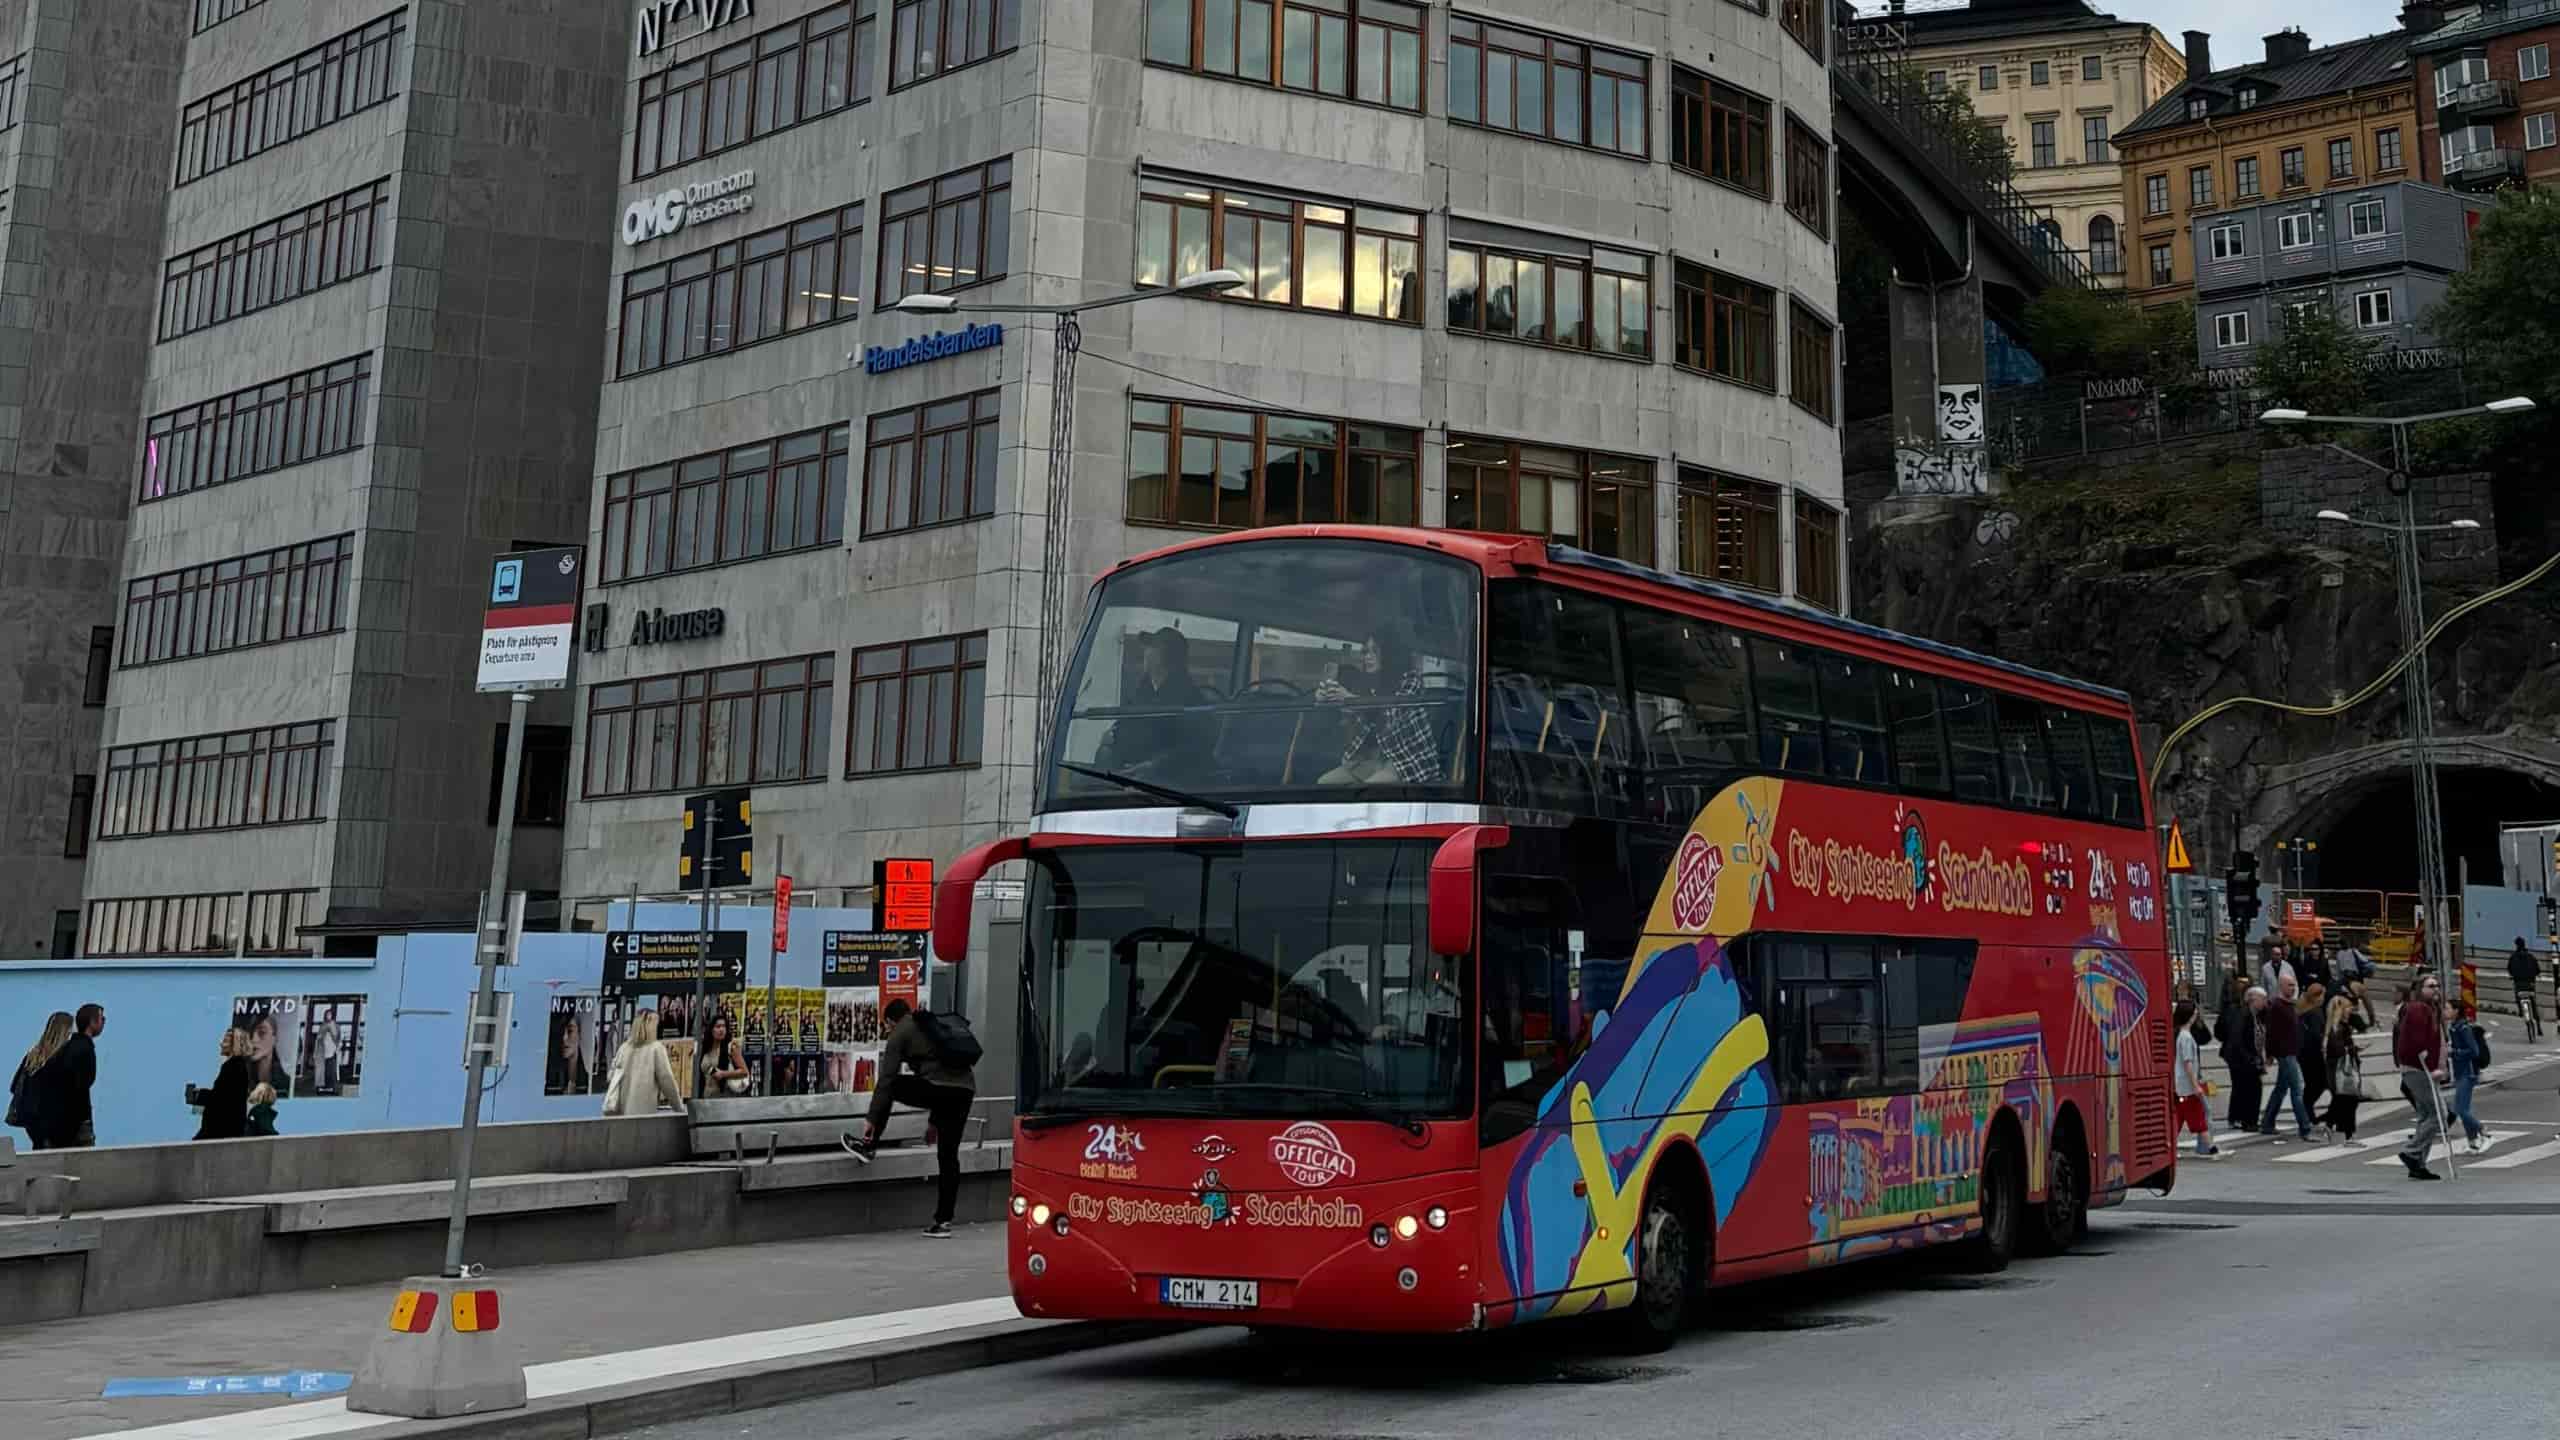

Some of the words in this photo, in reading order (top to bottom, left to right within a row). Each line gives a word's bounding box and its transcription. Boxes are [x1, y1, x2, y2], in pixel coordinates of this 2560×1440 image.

[686, 170, 754, 207] Omnicom
[622, 189, 687, 246] OMG
[865, 323, 1003, 375] Handelsbanken
[1677, 847, 1722, 917] OFFICIAL
[1788, 828, 1823, 896] City
[1824, 838, 1916, 911] Sightseeing
[2088, 848, 2105, 899] 24
[1694, 887, 1714, 923] TOUR
[1084, 1124, 1117, 1160] 24
[1274, 1143, 1348, 1175] OFFICIAL
[1292, 1166, 1328, 1184] TOUR
[1068, 1192, 1103, 1221] City
[1106, 1196, 1214, 1229] Sightseeing
[1246, 1193, 1362, 1228] Stockholm
[1172, 1281, 1205, 1301] CMW
[1219, 1282, 1252, 1304] 214
